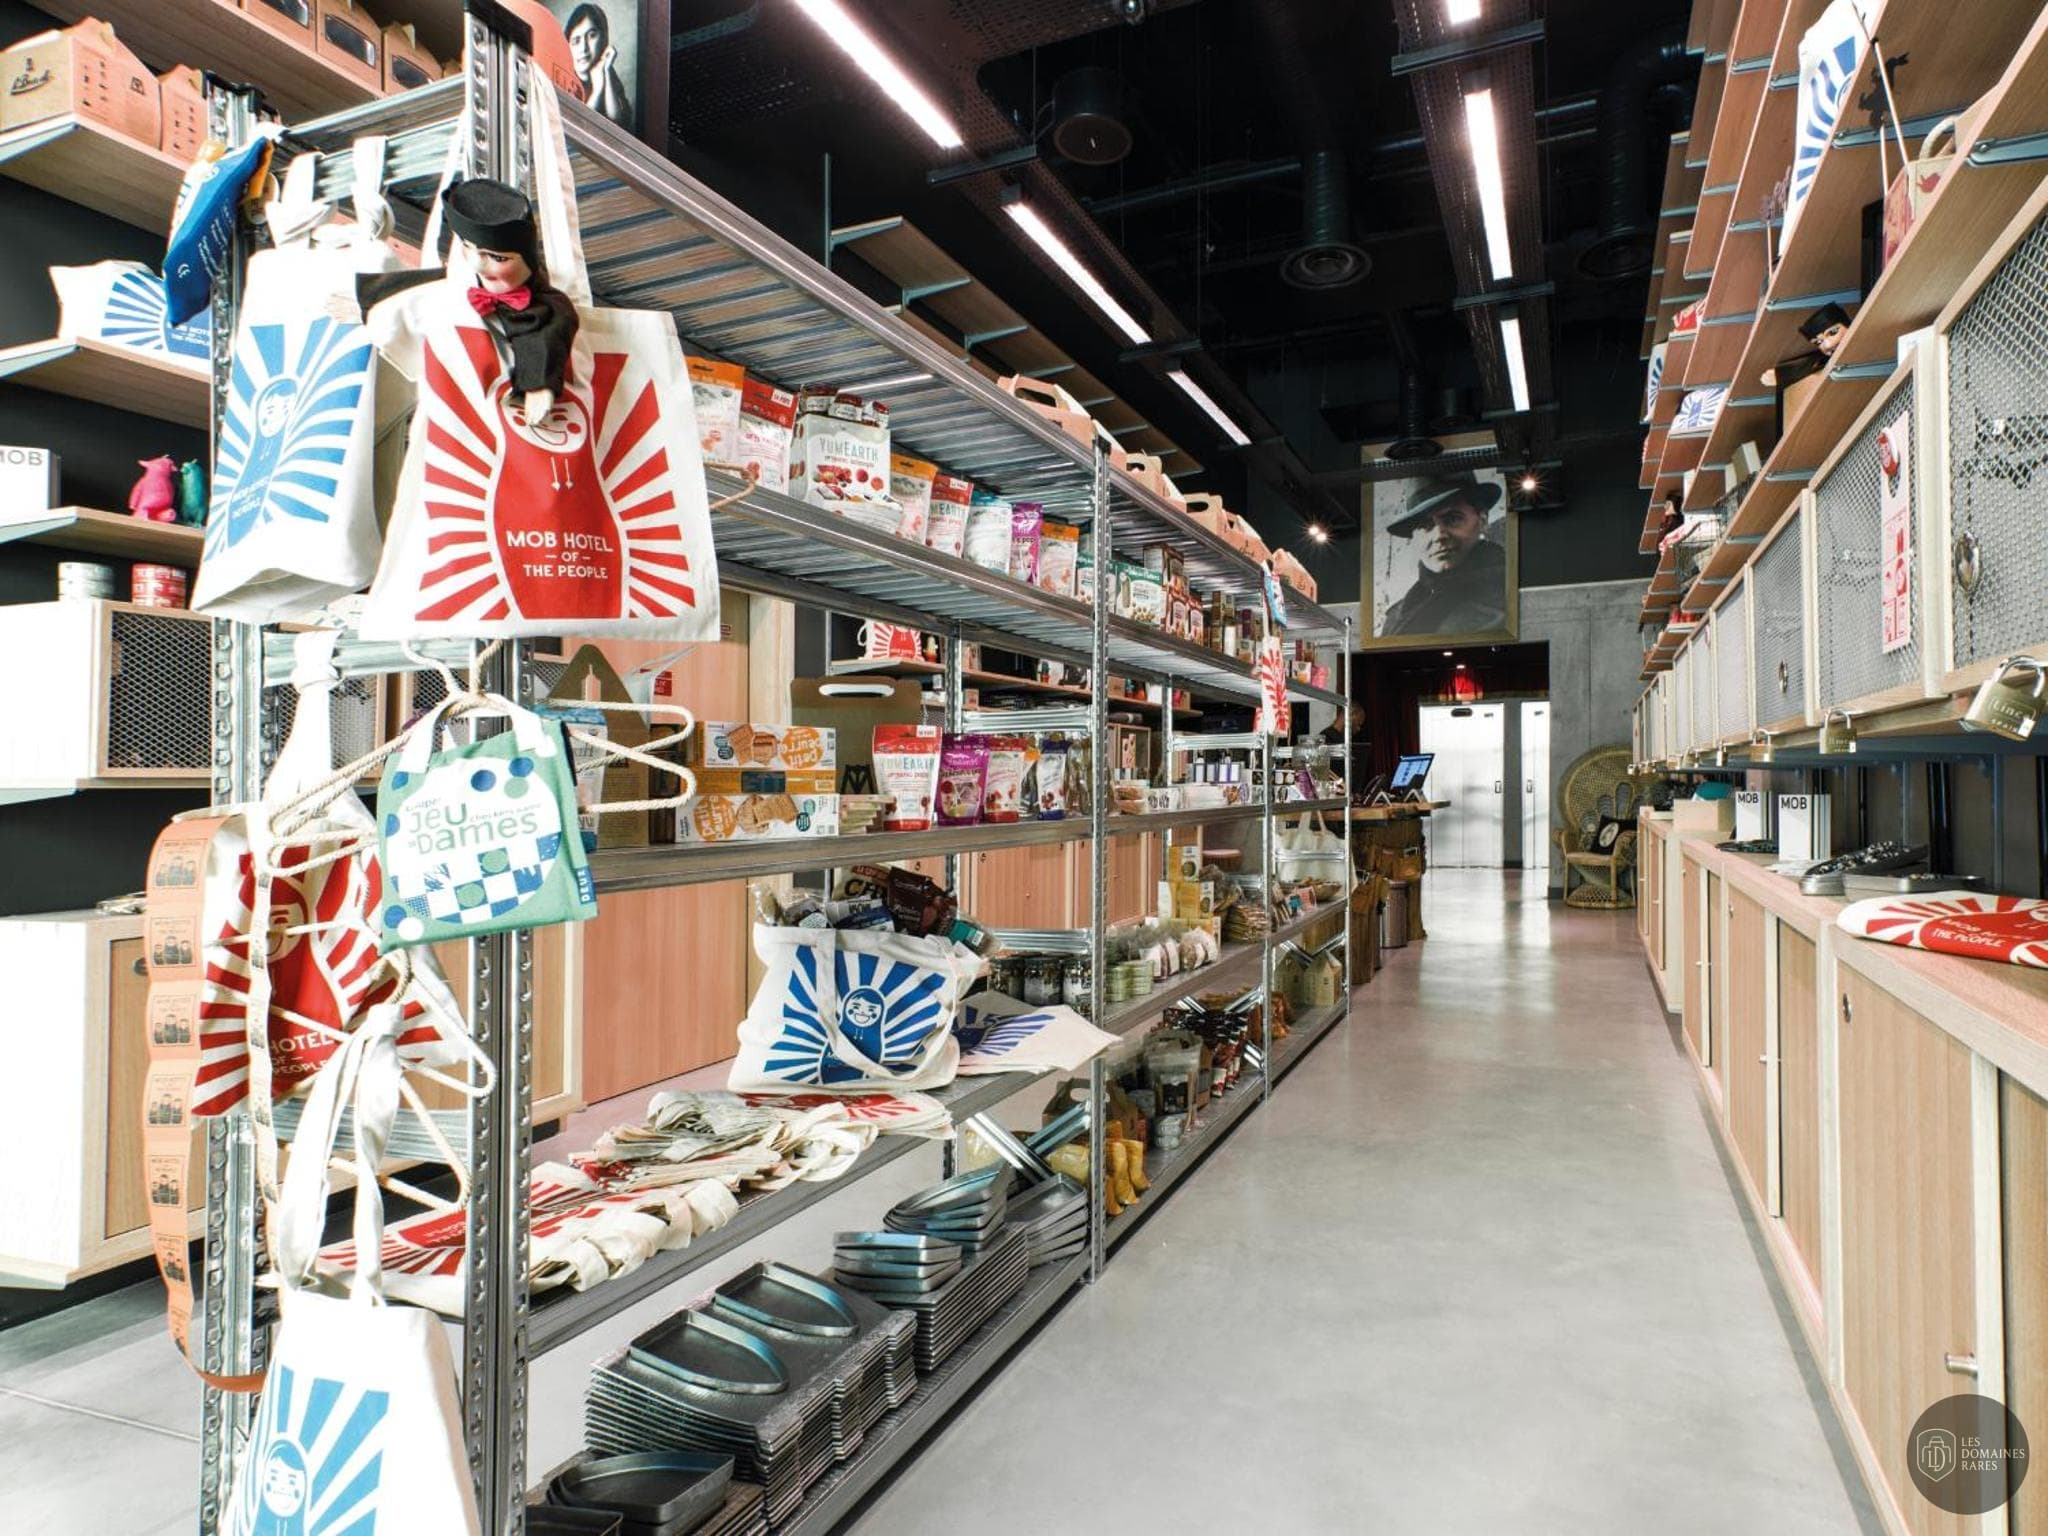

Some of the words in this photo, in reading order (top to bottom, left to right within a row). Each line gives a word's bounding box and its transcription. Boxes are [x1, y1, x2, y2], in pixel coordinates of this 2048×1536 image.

[506, 531, 557, 548] MOB
[563, 532, 614, 552] HOTEL
[561, 551, 580, 562] OF
[523, 564, 553, 577] THE
[558, 565, 608, 579] PEOPLE
[1738, 793, 1760, 804] MOB
[1780, 797, 1808, 810] MOB
[1931, 928, 1957, 940] THE
